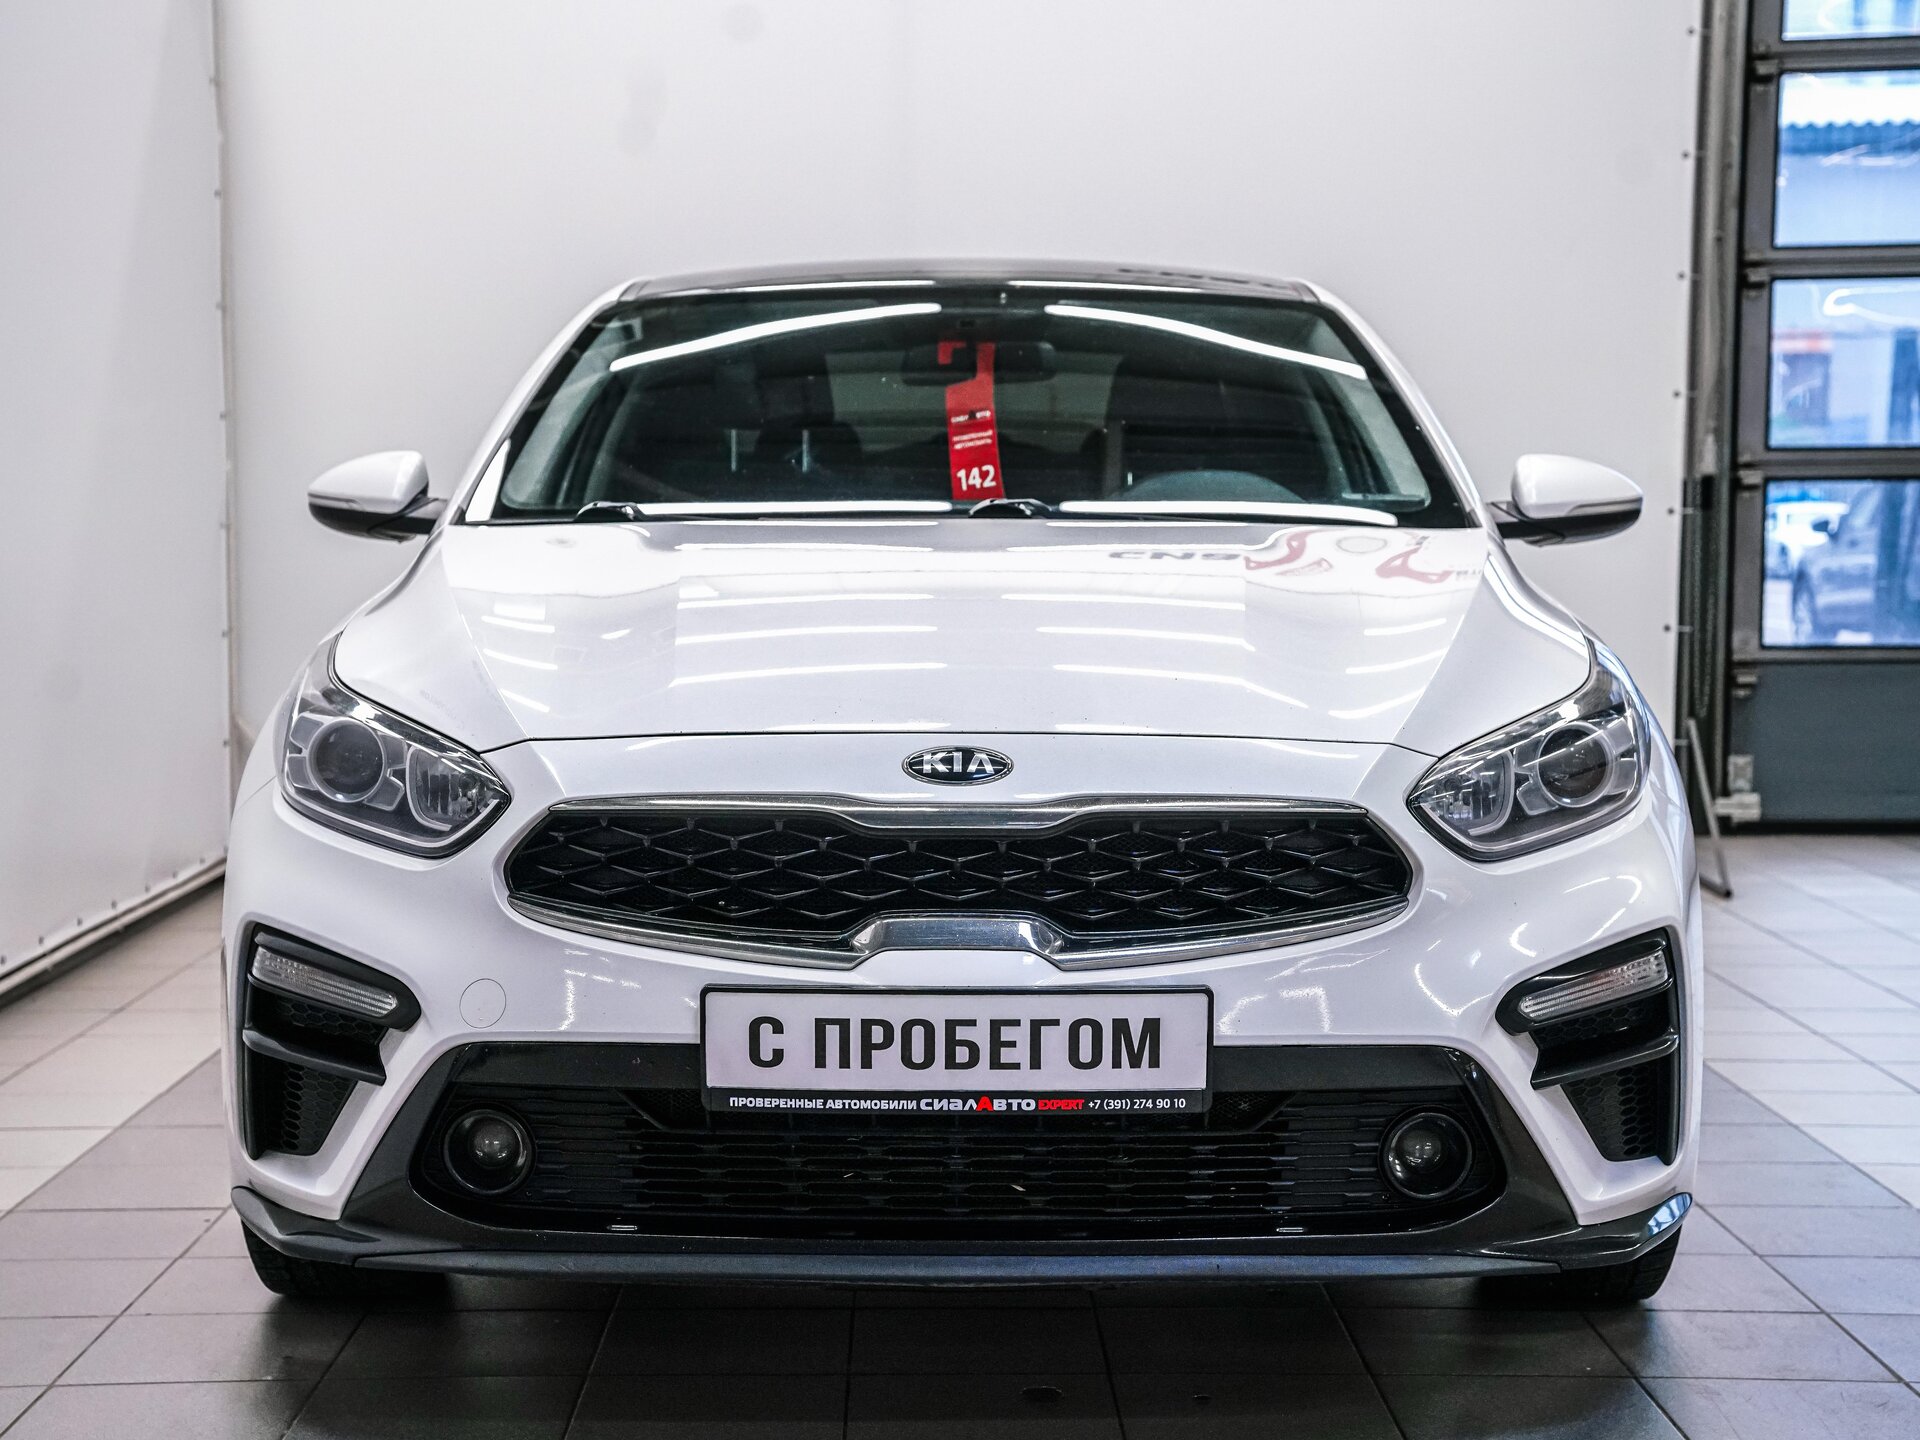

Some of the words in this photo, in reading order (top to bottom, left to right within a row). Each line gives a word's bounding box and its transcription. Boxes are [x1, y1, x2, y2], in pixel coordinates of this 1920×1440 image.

[956, 464, 997, 491] 142
[922, 751, 995, 774] KIA
[749, 1016, 785, 1068] С
[814, 1017, 1161, 1070] ПРОБЕГОМ
[729, 1097, 824, 1109] ПРОВЕРЕННЫЕ
[825, 1098, 917, 1110] АВТОМОБИЛИ
[1038, 1099, 1085, 1110] EXPERT
[1088, 1100, 1101, 1110] +7
[1103, 1099, 1131, 1110] (391)
[1133, 1099, 1153, 1109] 274
[1156, 1098, 1171, 1109] 90
[1173, 1098, 1186, 1109] 10
